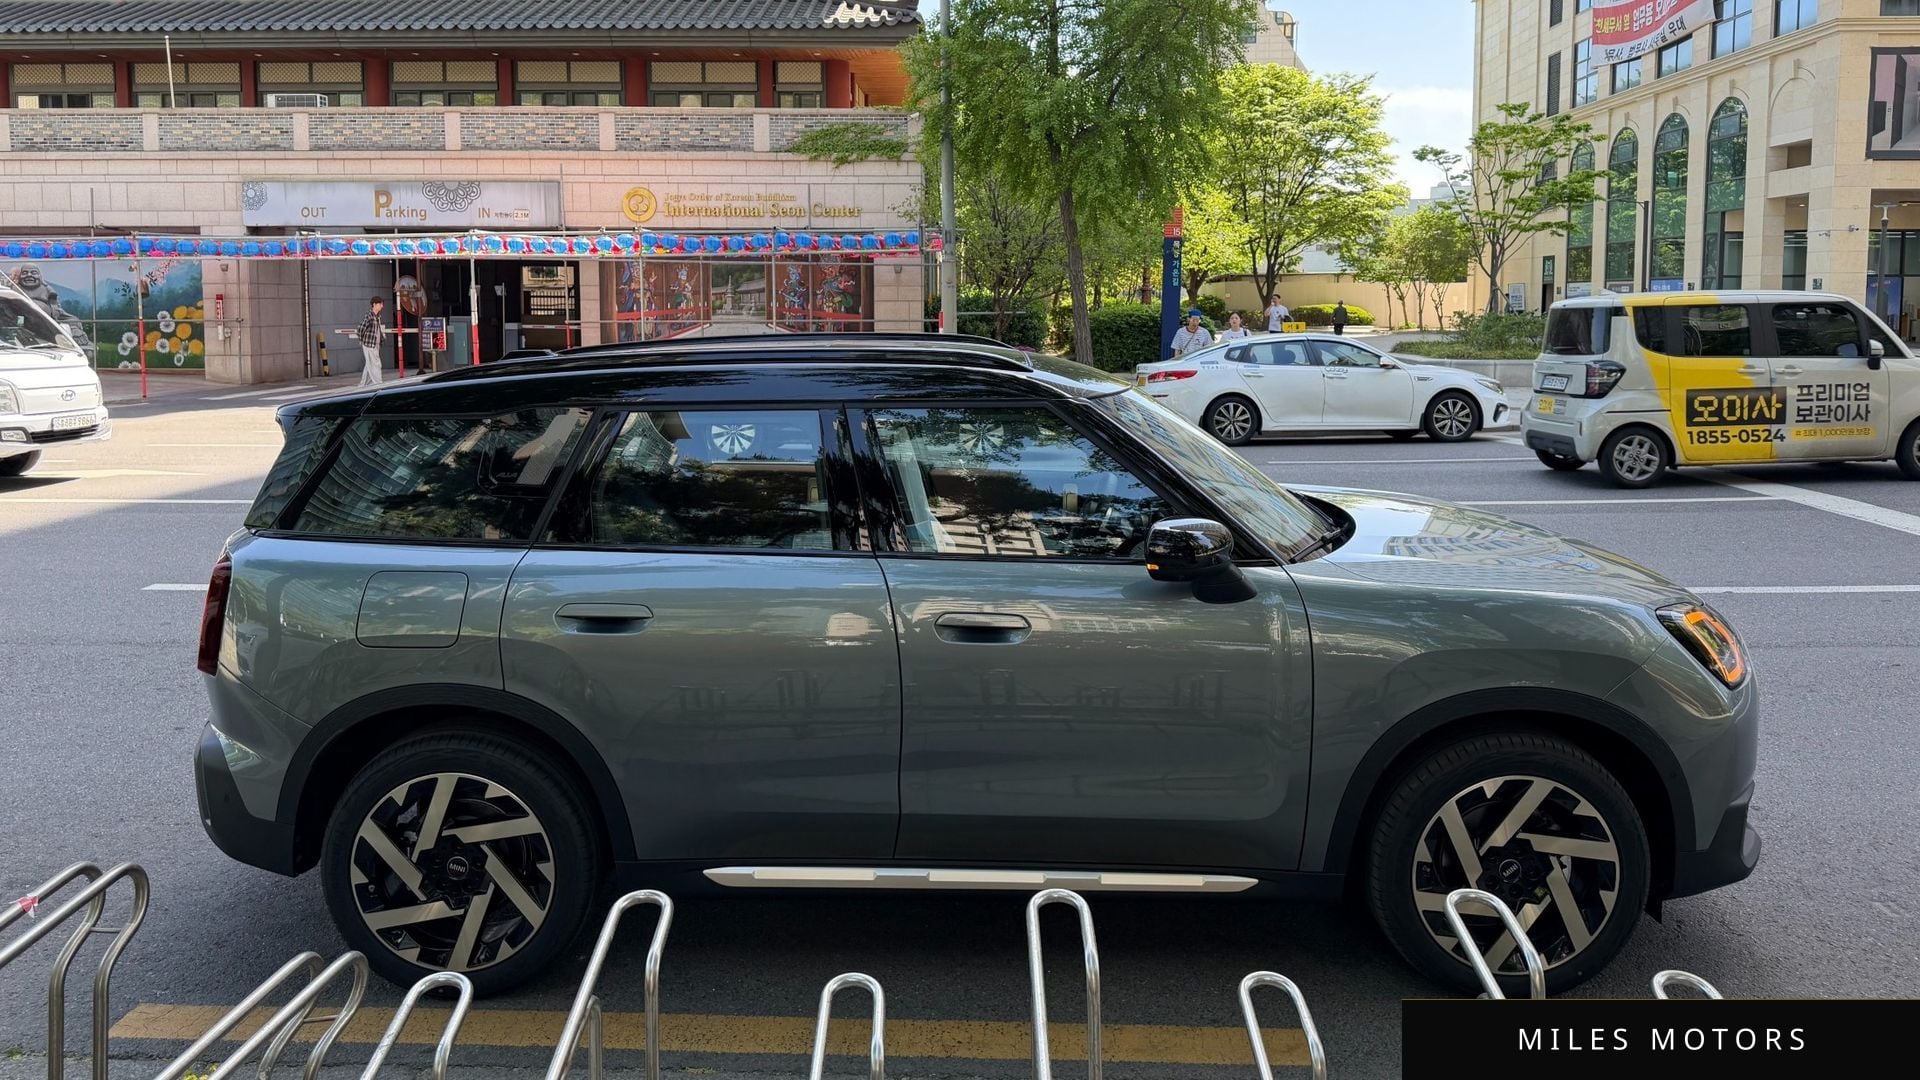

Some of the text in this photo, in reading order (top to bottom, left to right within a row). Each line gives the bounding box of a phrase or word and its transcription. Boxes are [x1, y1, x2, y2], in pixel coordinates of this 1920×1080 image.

[1668, 15, 1687, 37] 우대
[301, 207, 327, 218] OUT
[374, 190, 427, 221] Parking
[478, 207, 490, 218] IN
[664, 203, 862, 218] International Seon Center
[1796, 382, 1870, 402] 프리미엄
[1795, 403, 1871, 423] 보관이사
[1687, 428, 1786, 445] 1855-0524
[449, 863, 466, 873] MINI
[1503, 864, 1518, 877] MINI
